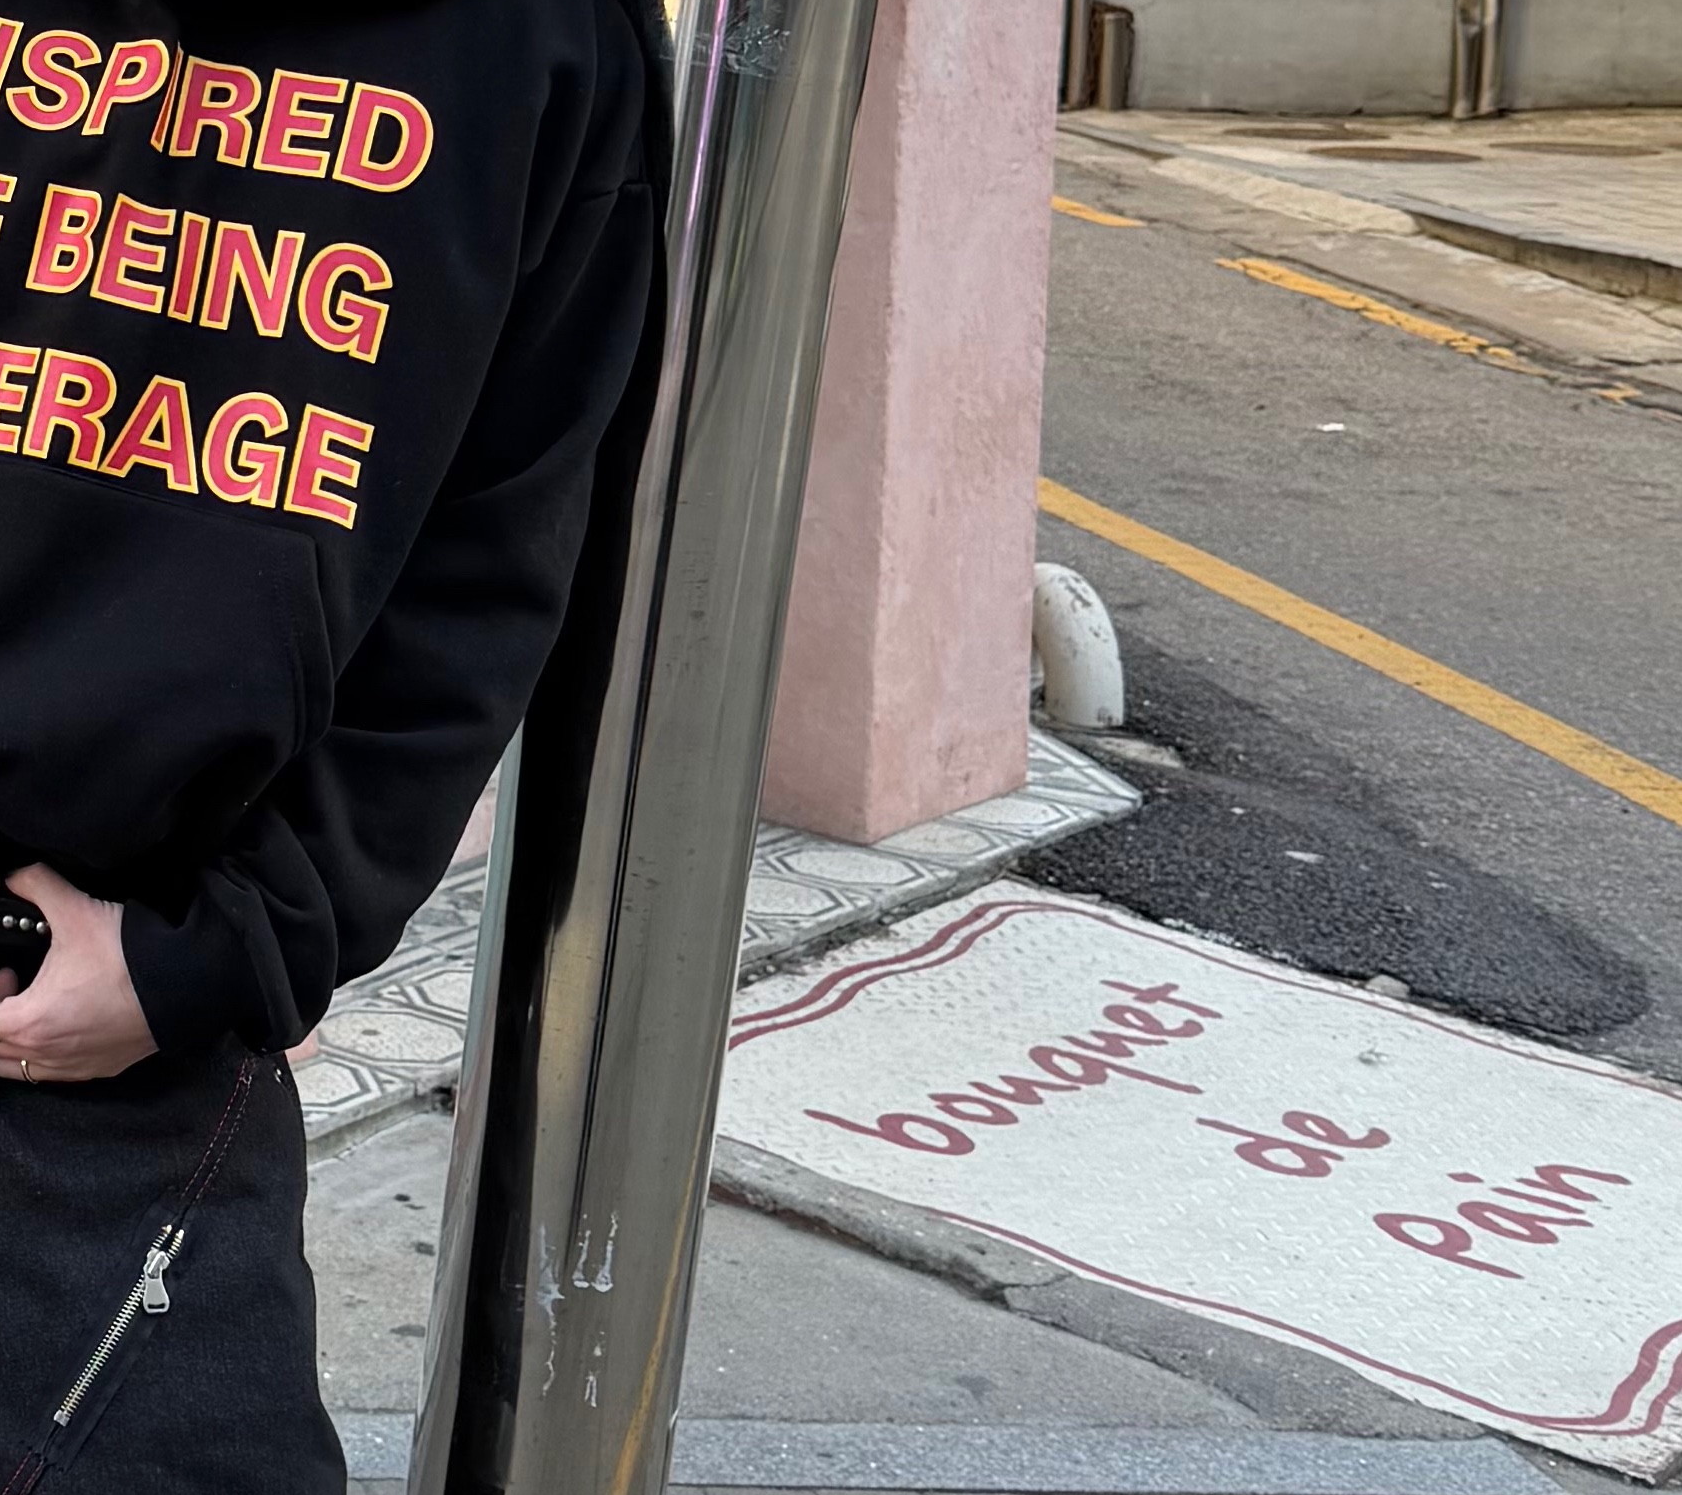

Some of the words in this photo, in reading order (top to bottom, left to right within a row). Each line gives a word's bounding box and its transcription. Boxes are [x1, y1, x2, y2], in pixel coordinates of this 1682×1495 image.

[25, 182, 393, 364] BEING
[803, 979, 1224, 1156] bouquet
[1195, 1110, 1392, 1178] de
[1372, 1163, 1633, 1280] Pain
